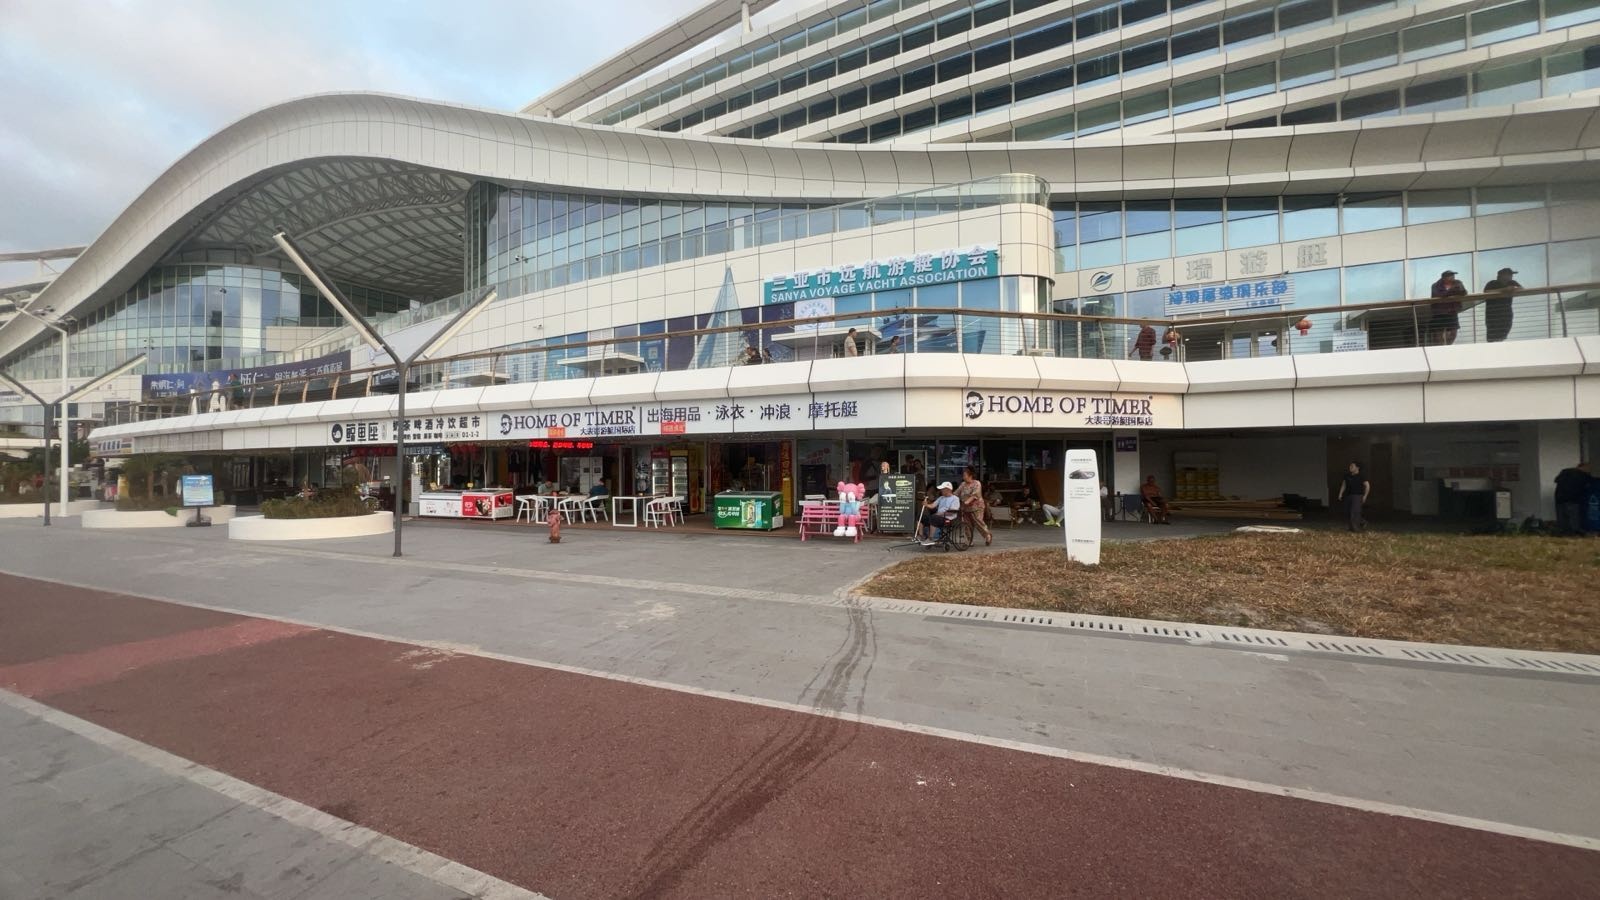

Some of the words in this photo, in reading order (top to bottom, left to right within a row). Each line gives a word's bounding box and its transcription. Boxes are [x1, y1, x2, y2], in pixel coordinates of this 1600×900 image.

[771, 245, 988, 292] 三亚市远航游艇协会
[771, 290, 808, 303] SANYA
[809, 283, 856, 299] VOYAGE
[858, 278, 897, 293] YACHT
[899, 266, 988, 287] ASSOCIATION
[988, 395, 1054, 414] HOME
[1059, 396, 1086, 414] OF
[1091, 397, 1153, 416] TIMER
[514, 414, 557, 429] HOME
[561, 412, 581, 427] OF
[585, 410, 635, 426] TIMER
[1084, 415, 1153, 426] 大表哥游艇国际店
